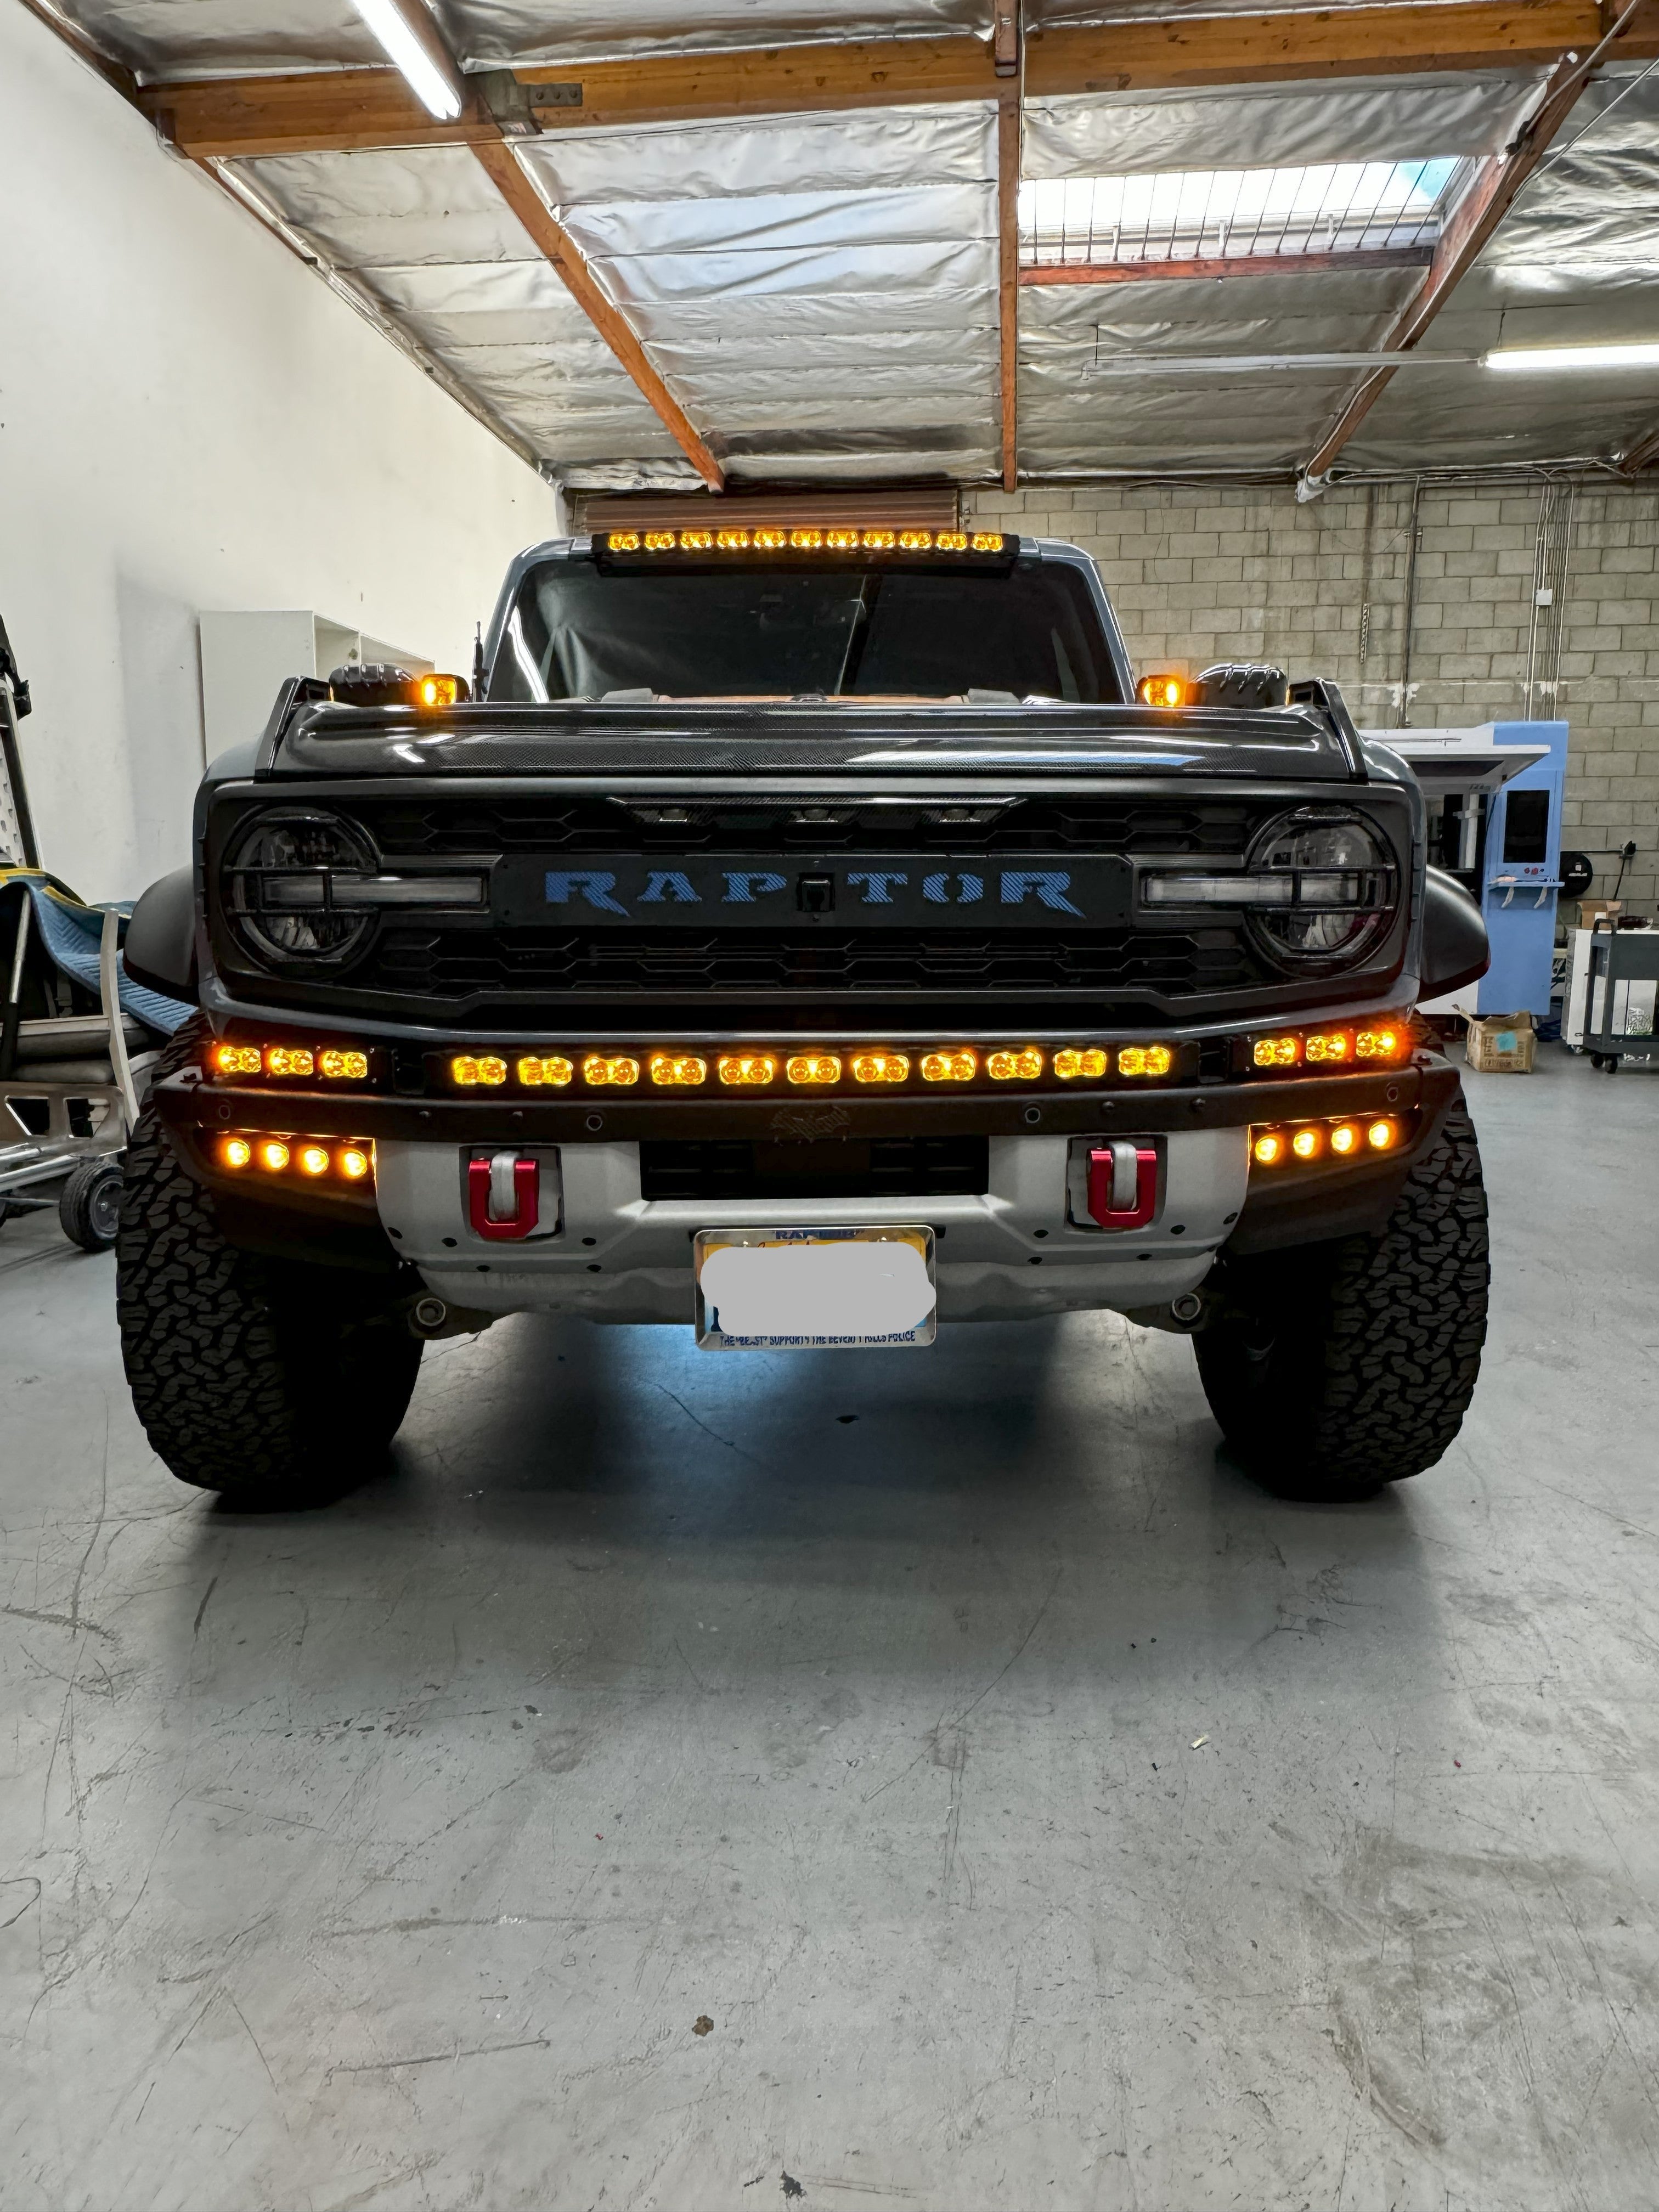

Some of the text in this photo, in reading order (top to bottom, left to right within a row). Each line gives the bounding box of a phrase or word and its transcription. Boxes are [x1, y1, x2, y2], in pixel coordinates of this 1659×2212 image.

[546, 872, 1085, 918] RAPTOR
[719, 1335, 735, 1347] THE
[812, 1336, 827, 1345] THE
[888, 1331, 916, 1342] POLICE
